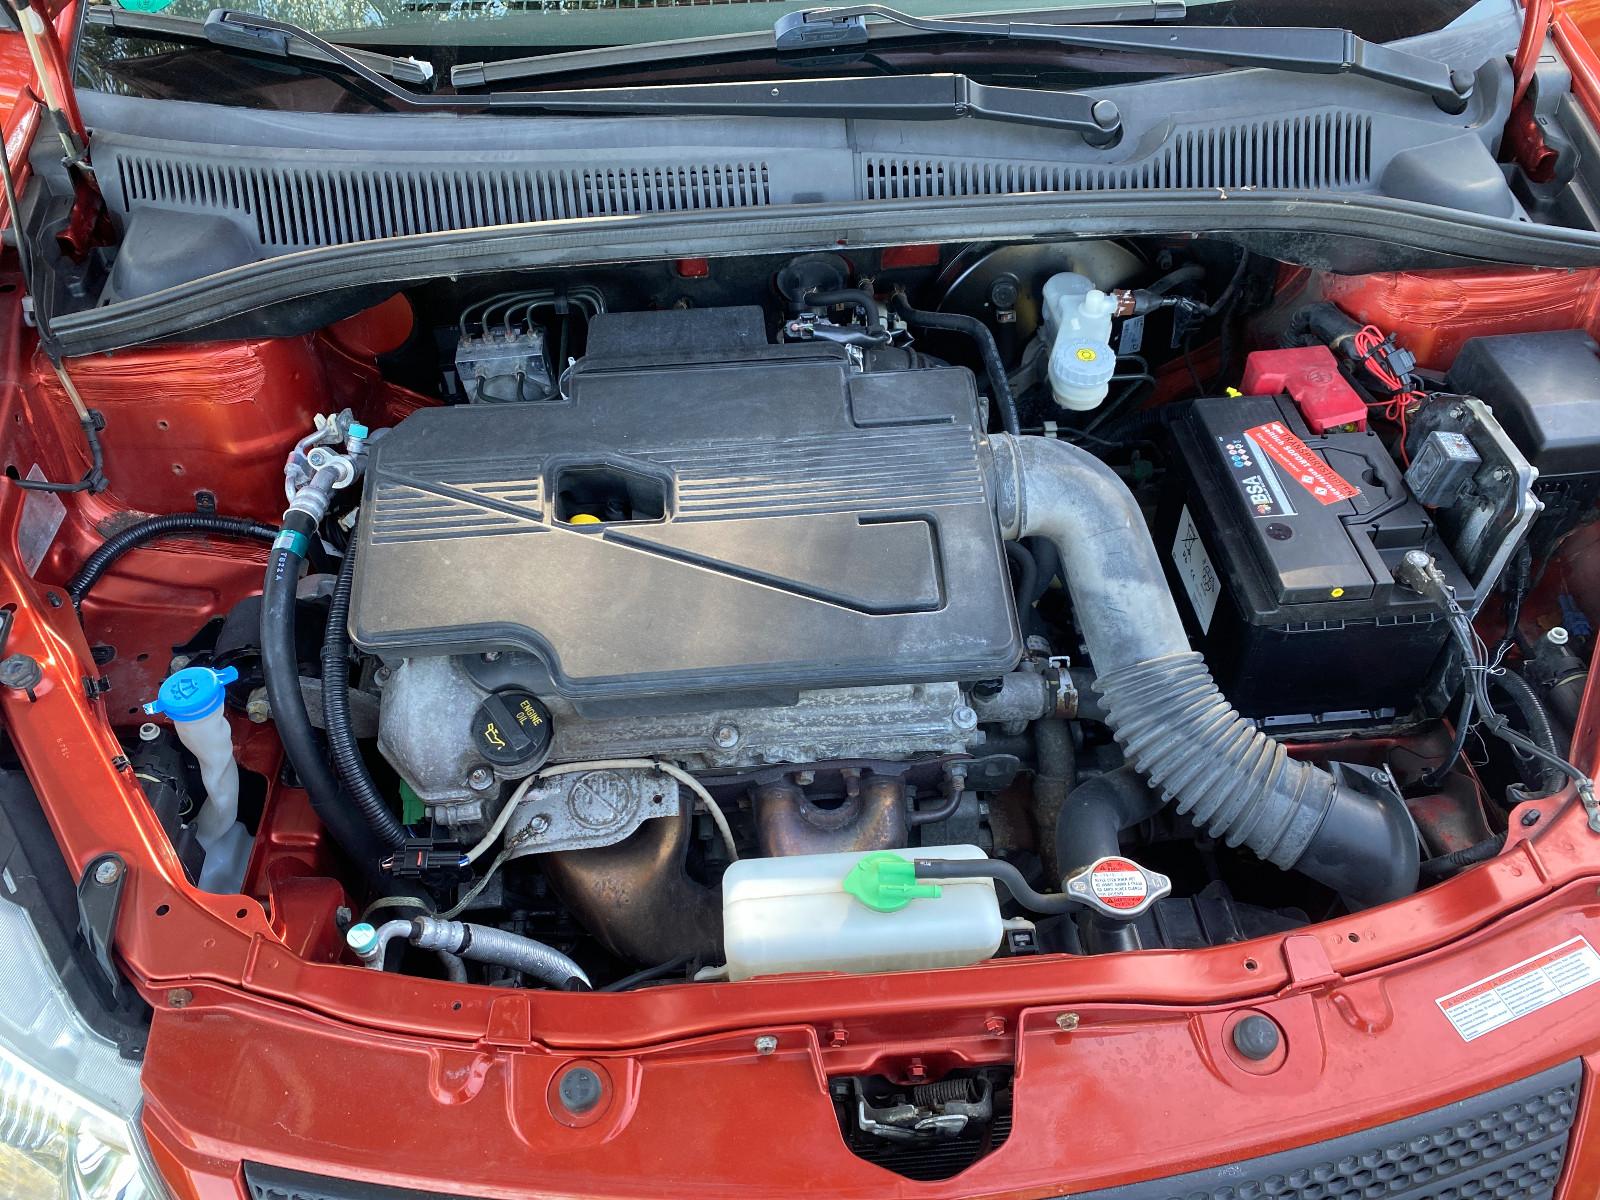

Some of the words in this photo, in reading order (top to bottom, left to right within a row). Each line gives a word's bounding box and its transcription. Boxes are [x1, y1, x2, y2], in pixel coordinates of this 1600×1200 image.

[1283, 445, 1312, 468] SOFORT
[1242, 475, 1268, 505] BSA
[516, 712, 527, 727] OIL
[520, 700, 542, 726] ENGINE
